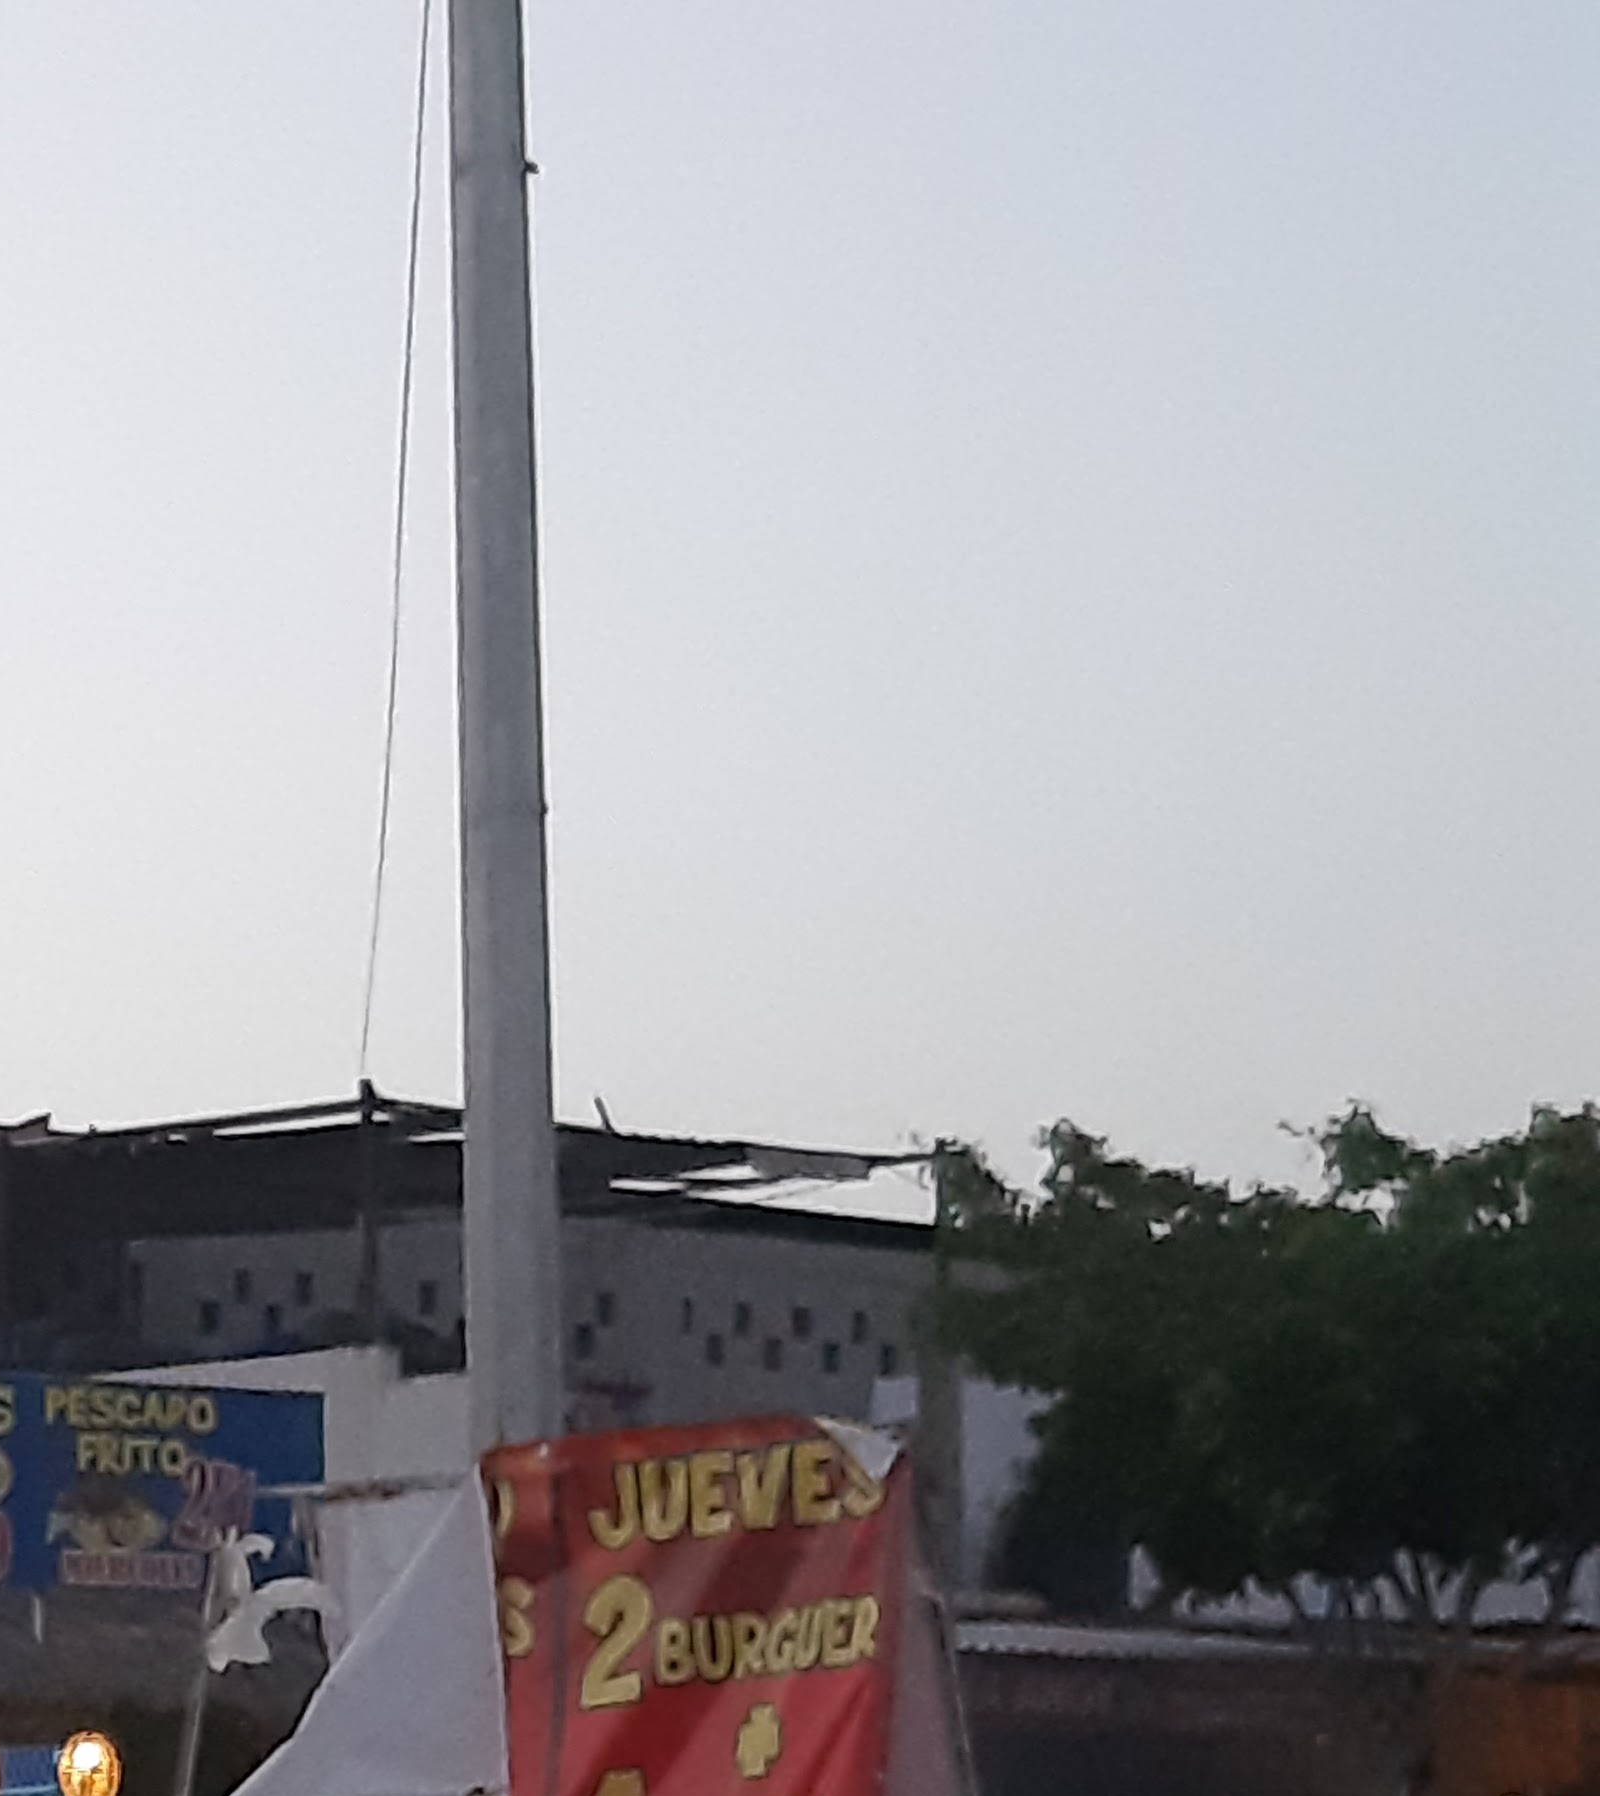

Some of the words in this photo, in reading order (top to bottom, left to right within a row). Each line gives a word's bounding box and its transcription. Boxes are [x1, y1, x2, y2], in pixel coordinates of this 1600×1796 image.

[45, 1385, 218, 1435] PESCADO
[76, 1431, 187, 1477] FRITO
[580, 1573, 653, 1710] 2
[654, 1595, 882, 1686] BURGUER
